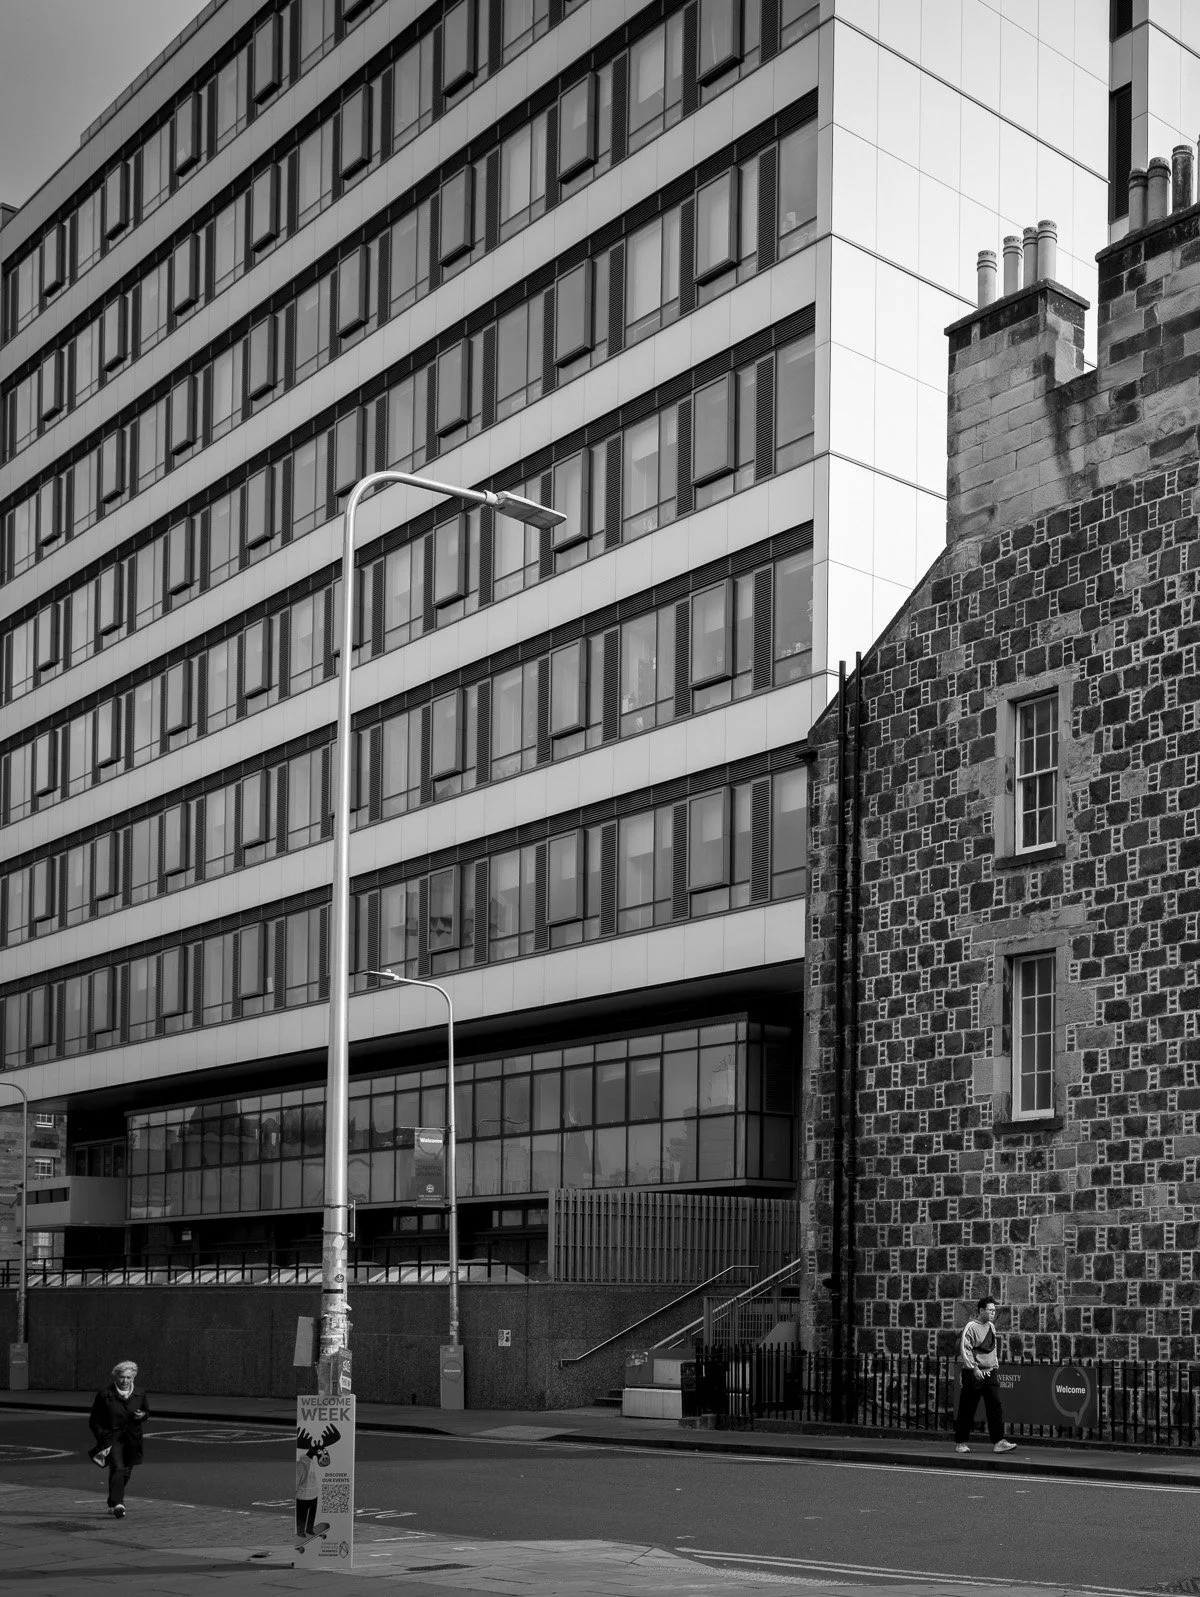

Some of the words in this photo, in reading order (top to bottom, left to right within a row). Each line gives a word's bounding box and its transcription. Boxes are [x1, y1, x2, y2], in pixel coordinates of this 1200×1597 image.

[1056, 1385, 1086, 1394] Welcome
[301, 1398, 351, 1406] WELCOME
[301, 1408, 350, 1422] WEEK
